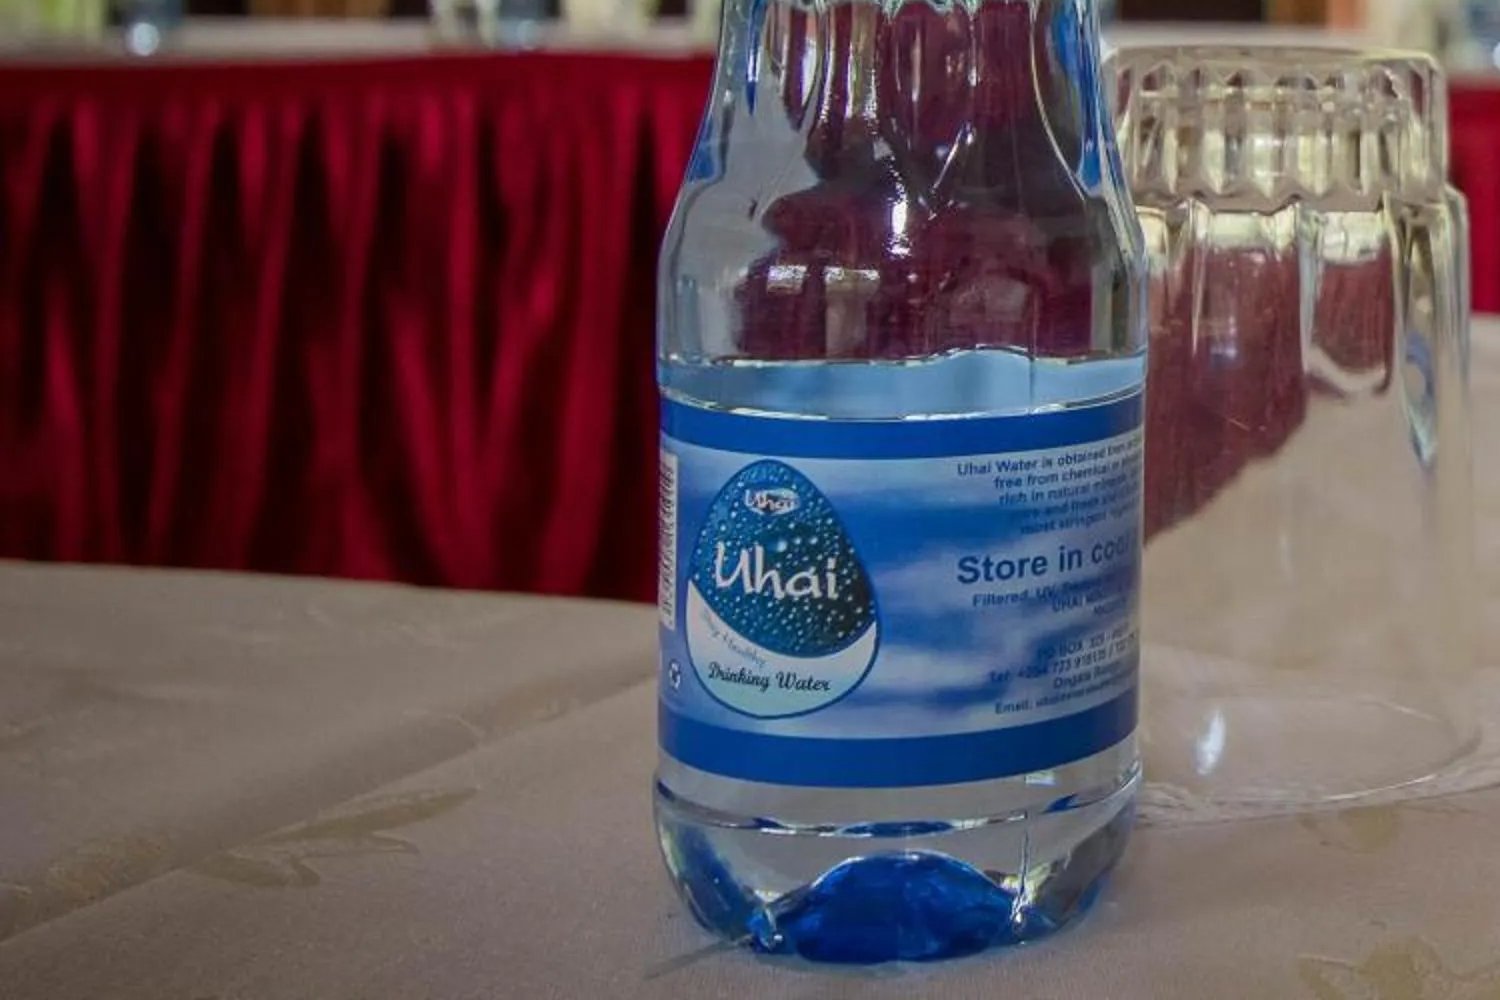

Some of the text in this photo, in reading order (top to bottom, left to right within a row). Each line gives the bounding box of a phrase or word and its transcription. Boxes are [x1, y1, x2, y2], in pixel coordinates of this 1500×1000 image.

[957, 461, 992, 477] Uhai
[996, 457, 1038, 474] Water
[1041, 455, 1053, 468] is
[993, 475, 1023, 490] free
[1027, 472, 1059, 487] from
[999, 490, 1027, 507] rich
[1031, 489, 1045, 502] in
[1047, 482, 1091, 500] natural
[714, 540, 839, 600] Uhai
[957, 554, 1048, 585] Store
[1058, 545, 1083, 573] in
[708, 661, 831, 693] Drinking Water
